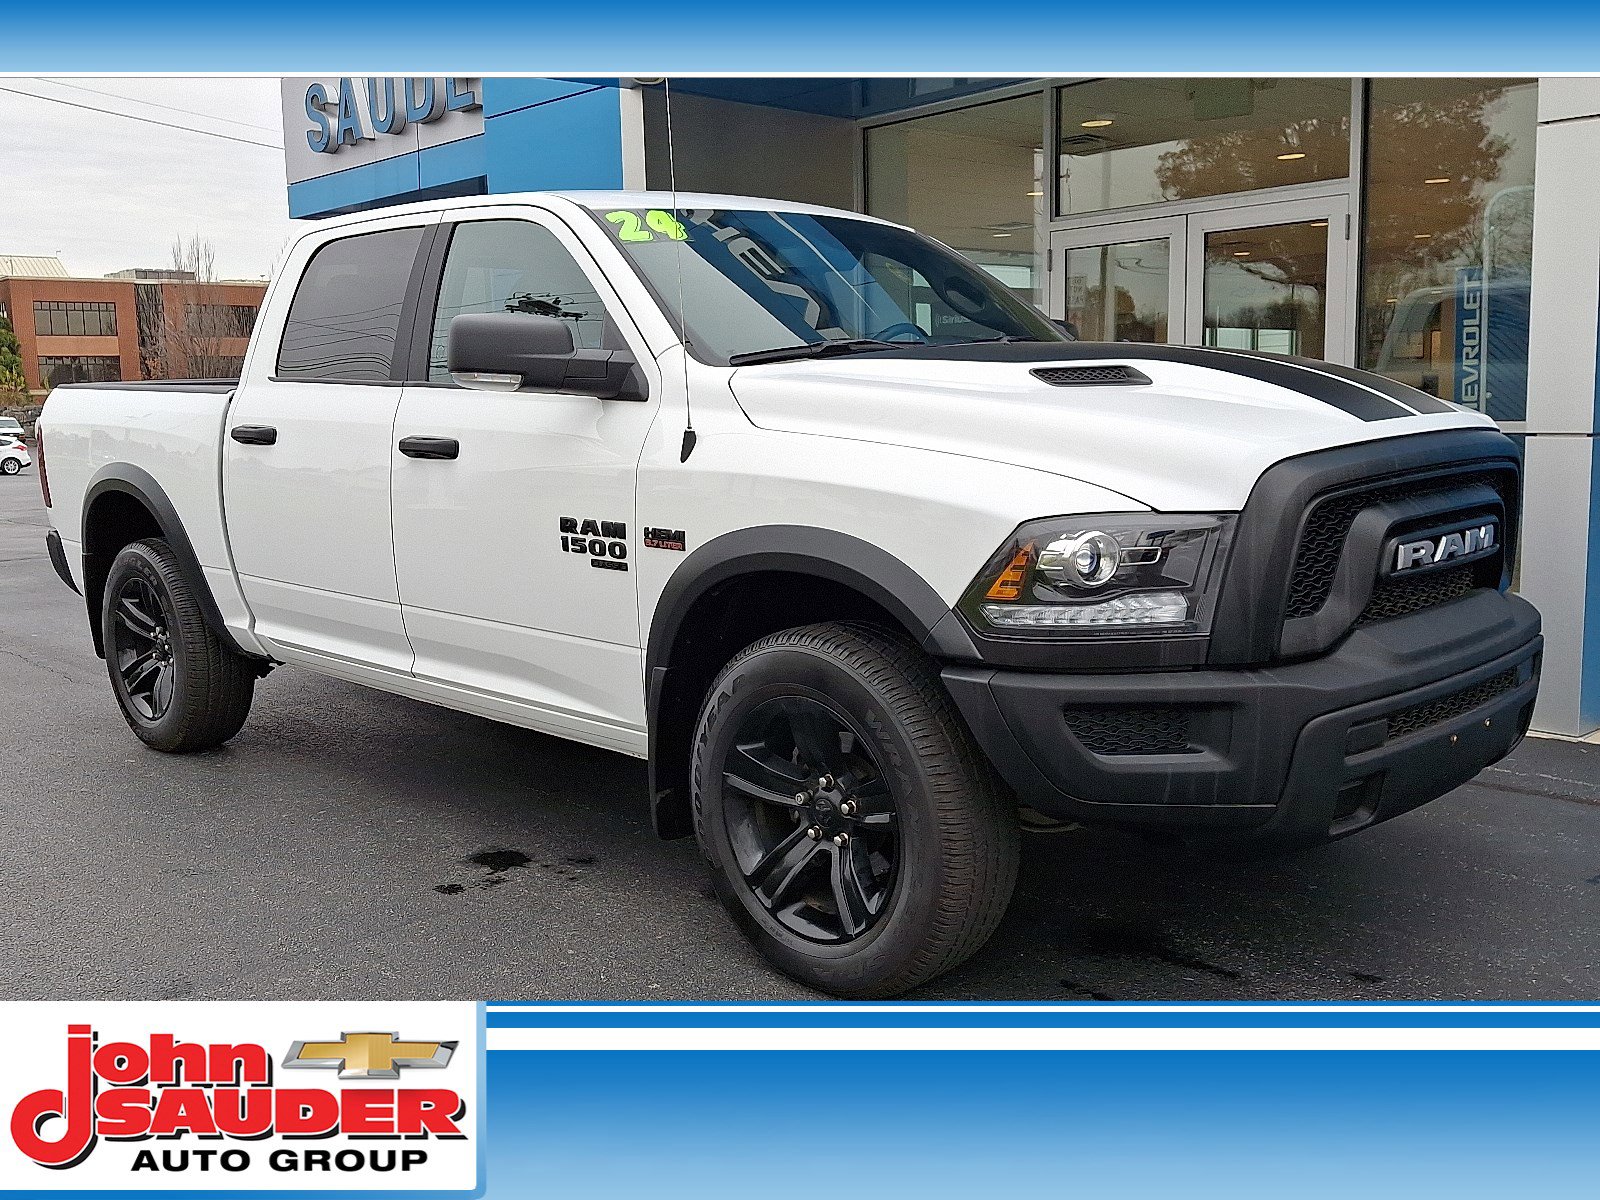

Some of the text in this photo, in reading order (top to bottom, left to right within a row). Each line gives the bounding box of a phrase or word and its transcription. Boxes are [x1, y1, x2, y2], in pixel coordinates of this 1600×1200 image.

[559, 516, 627, 540] RAM
[643, 526, 686, 541] HEMI
[560, 535, 628, 560] 1500
[1396, 523, 1495, 571] RAM
